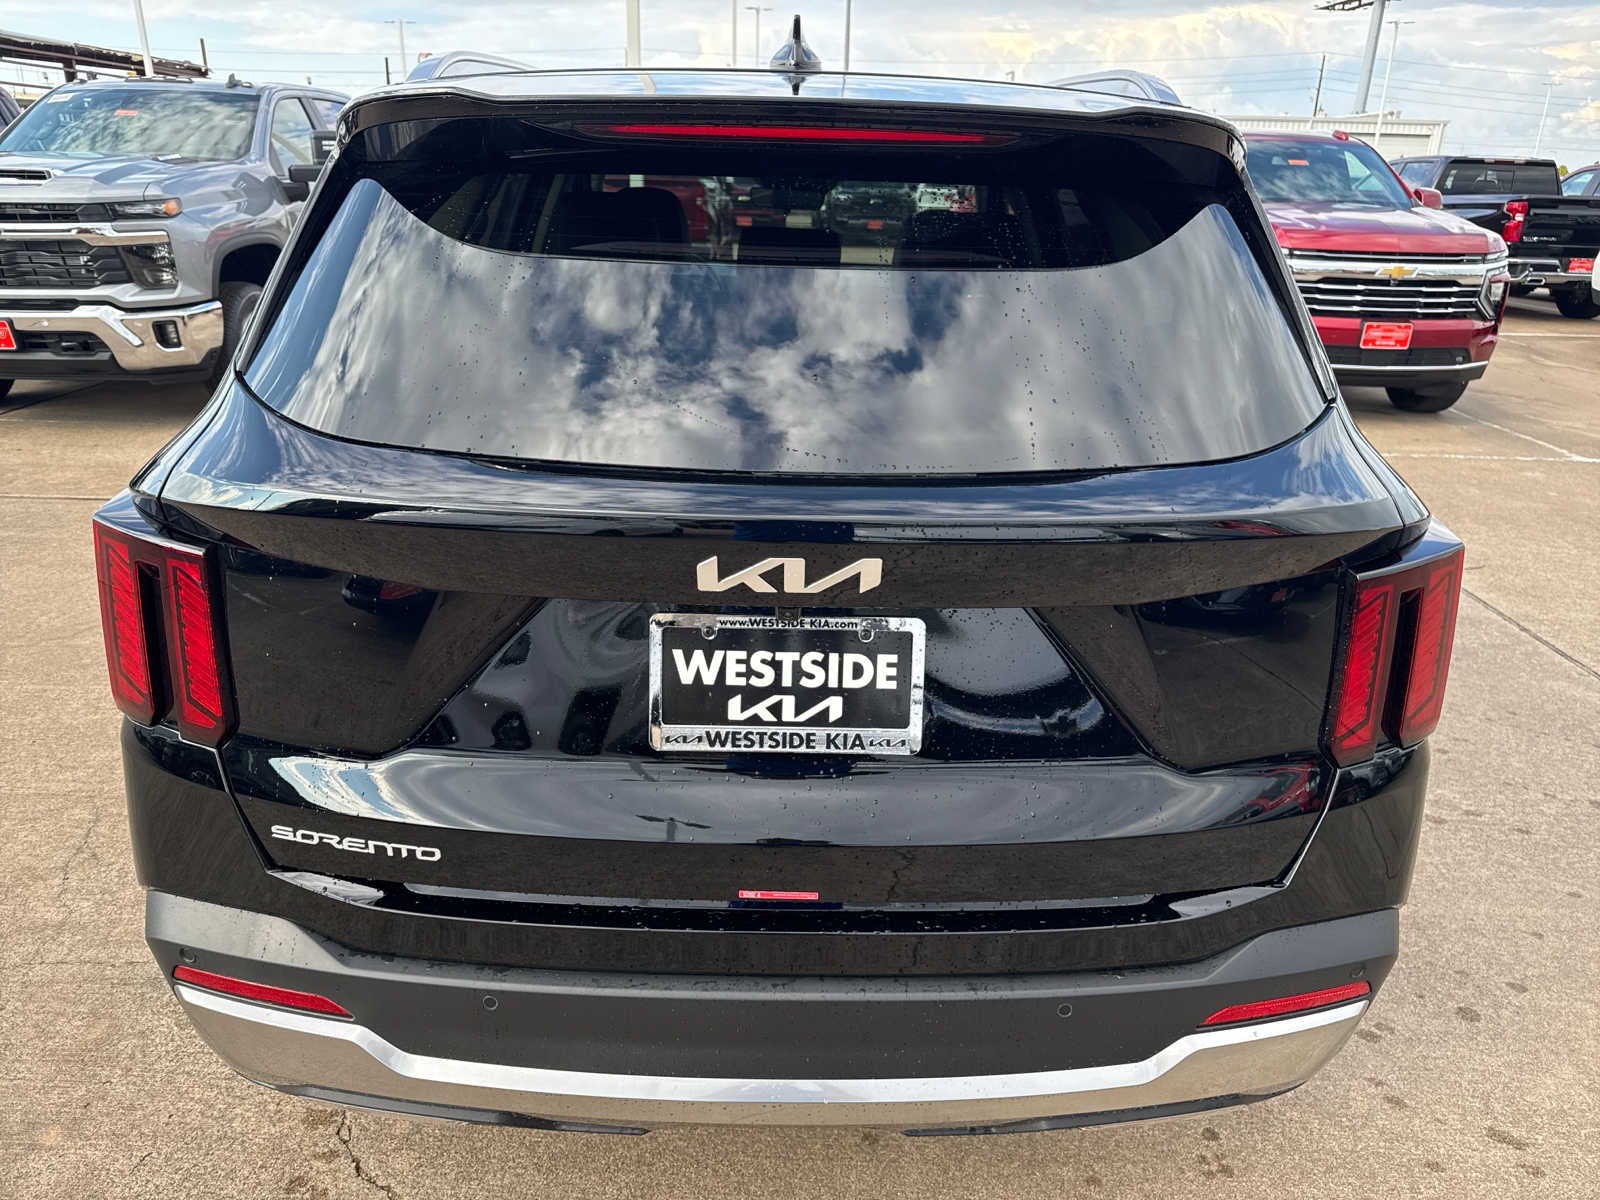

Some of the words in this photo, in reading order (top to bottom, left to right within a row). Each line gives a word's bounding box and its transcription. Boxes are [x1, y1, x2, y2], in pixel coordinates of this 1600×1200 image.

[696, 555, 884, 594] KIA
[719, 618, 805, 629] www.WESTSIDE
[809, 619, 858, 630] KIA.com
[671, 648, 899, 690] WESTSIDE
[727, 694, 844, 723] KIA
[705, 730, 817, 750] WESTSIDE
[826, 732, 866, 751] KIA
[271, 824, 442, 862] SORENTO
